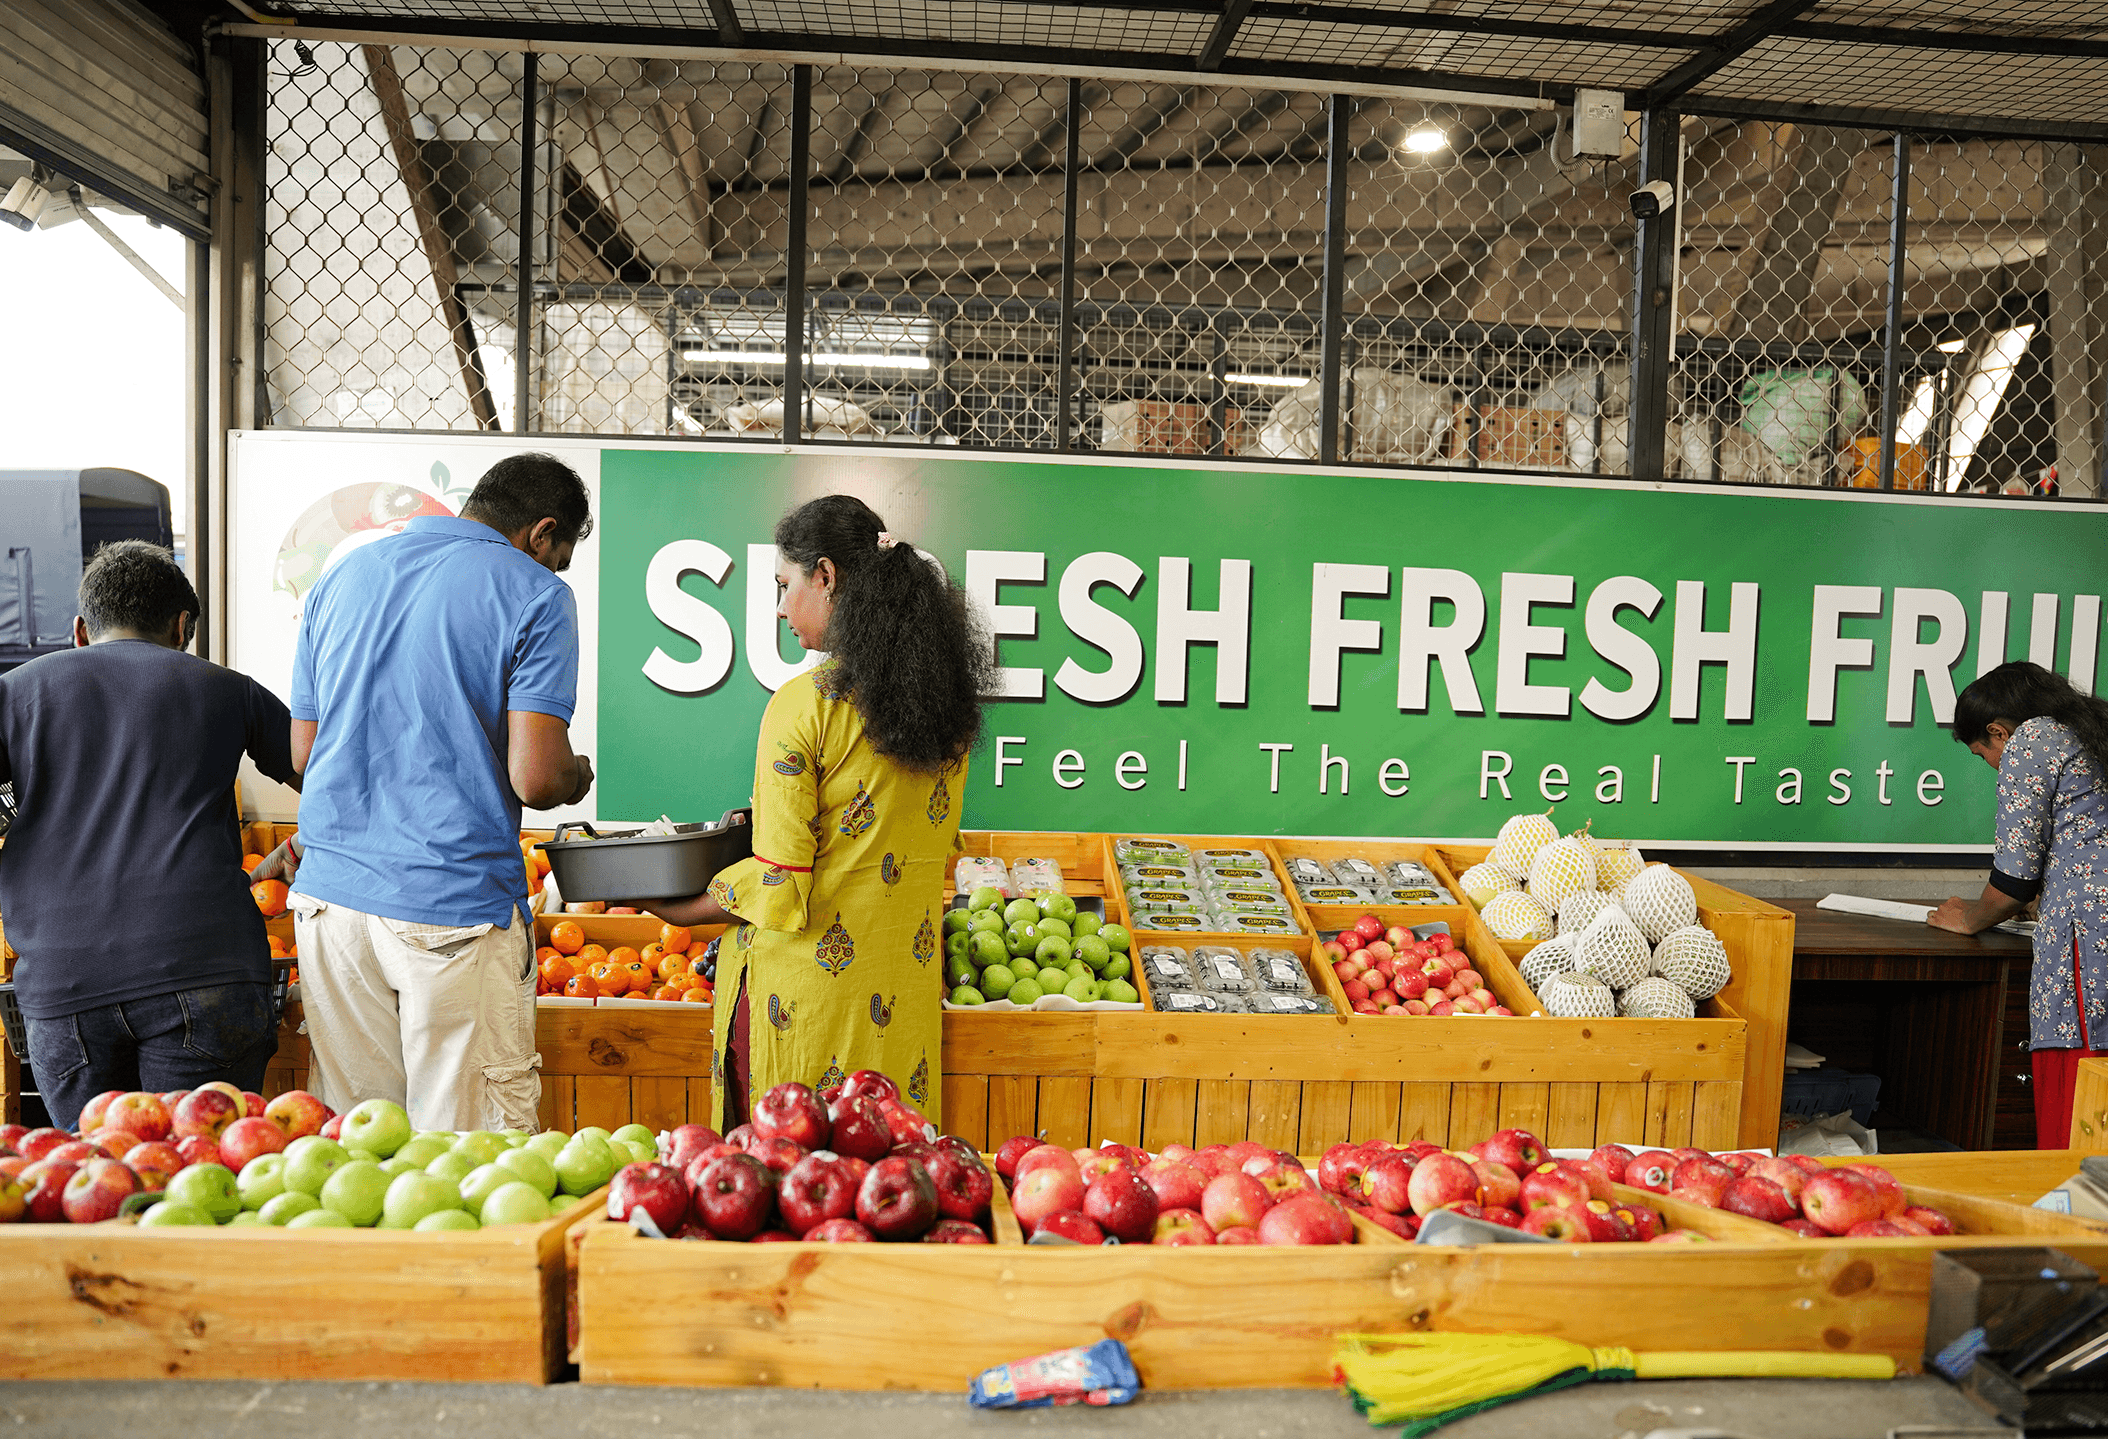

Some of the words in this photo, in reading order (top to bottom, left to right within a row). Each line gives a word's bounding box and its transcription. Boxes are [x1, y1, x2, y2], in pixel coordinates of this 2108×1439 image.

[641, 539, 1251, 704] SUESH
[1308, 562, 1759, 720] FRESH
[1807, 585, 2108, 724] FRUI
[995, 736, 1188, 790] Feel
[1259, 743, 1411, 797] The
[1480, 750, 1661, 803] Real
[1725, 756, 1945, 806] Taste
